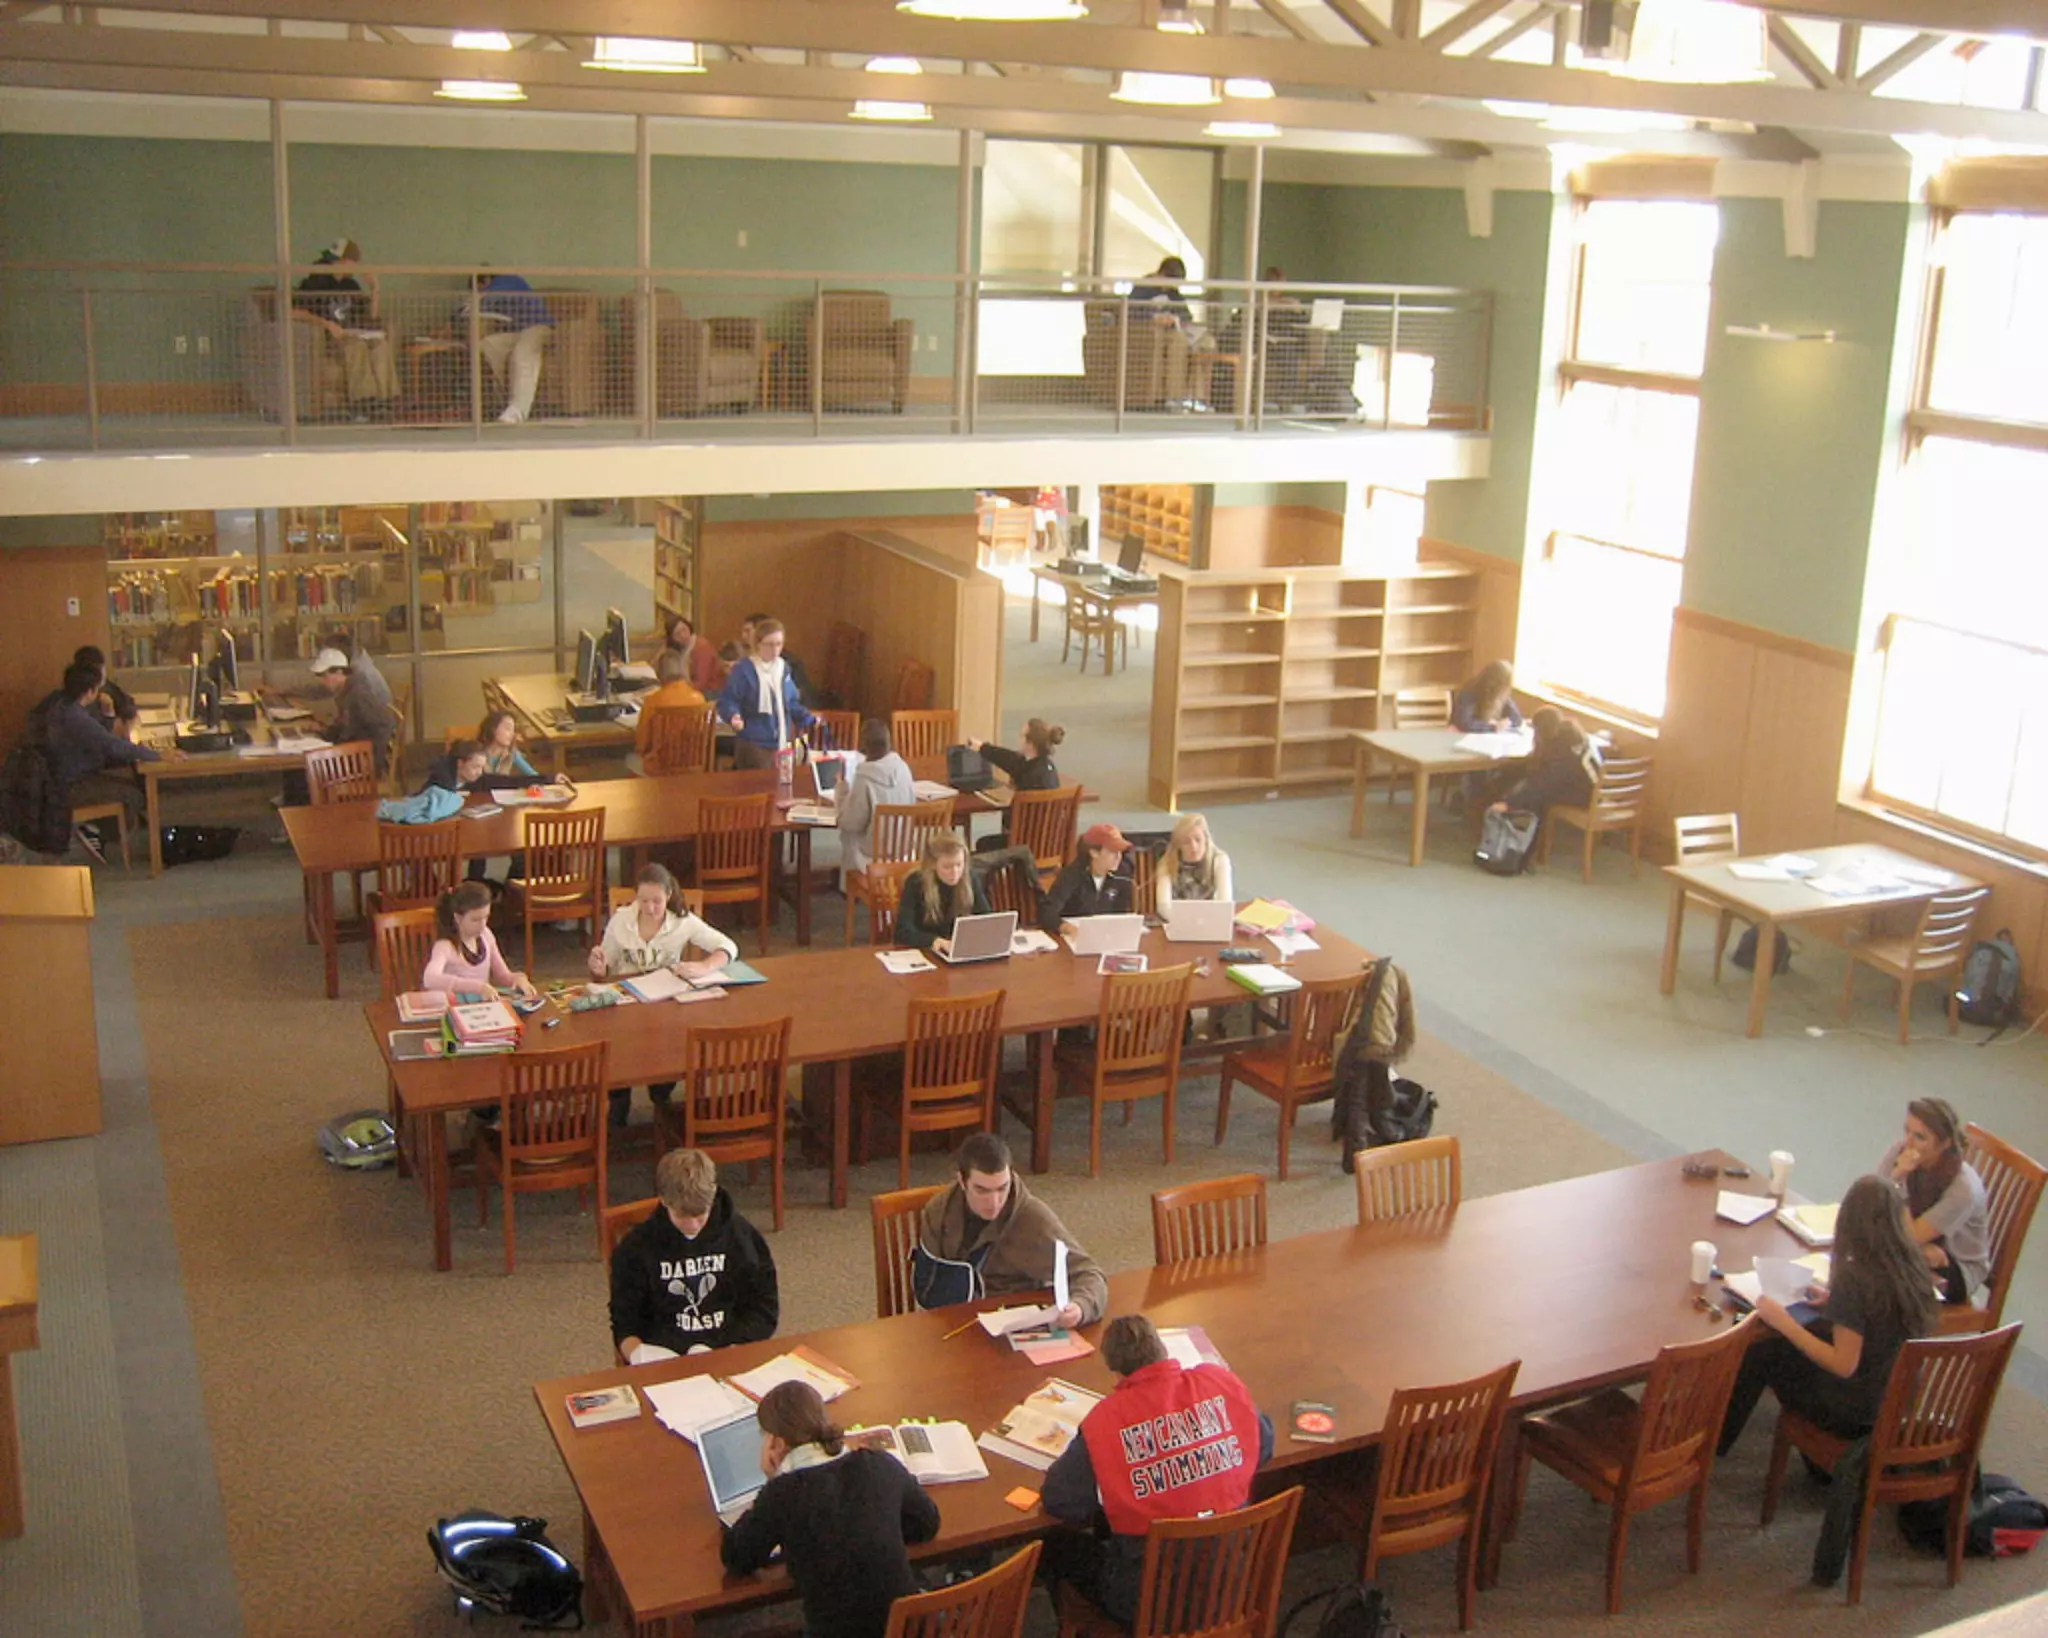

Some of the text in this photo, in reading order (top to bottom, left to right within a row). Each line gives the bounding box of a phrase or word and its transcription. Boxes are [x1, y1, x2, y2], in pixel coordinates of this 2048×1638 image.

[660, 1253, 726, 1279] DARIEN
[1120, 1420, 1157, 1464] NEW
[1130, 1435, 1243, 1499] SWIMMING
